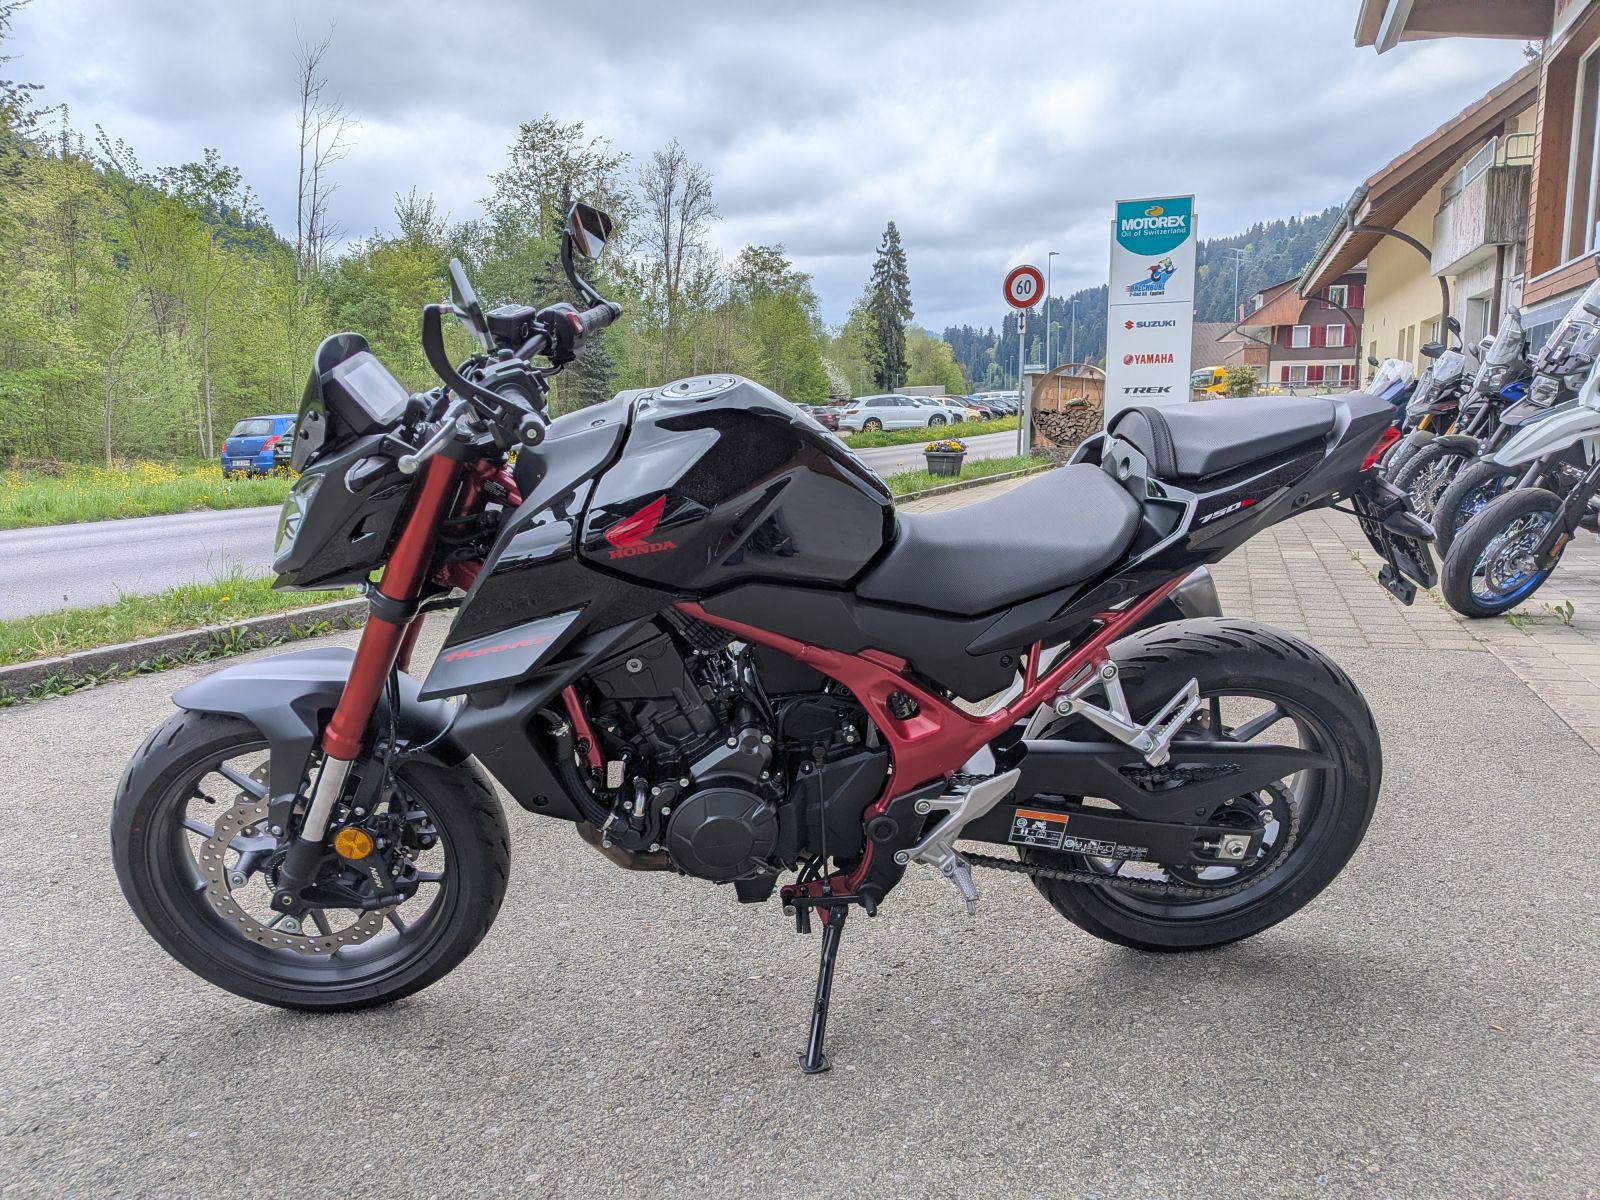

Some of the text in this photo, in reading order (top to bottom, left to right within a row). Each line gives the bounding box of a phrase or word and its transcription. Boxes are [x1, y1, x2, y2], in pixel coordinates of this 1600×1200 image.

[1121, 215, 1186, 230] MOTOREX
[1144, 227, 1187, 236] Switzerland
[1016, 279, 1032, 295] 60
[1136, 320, 1176, 328] SUZUKI
[1134, 353, 1174, 365] YAMAHA
[1122, 386, 1173, 394] TREK
[1199, 501, 1242, 524] 750
[609, 540, 676, 559] HONDA
